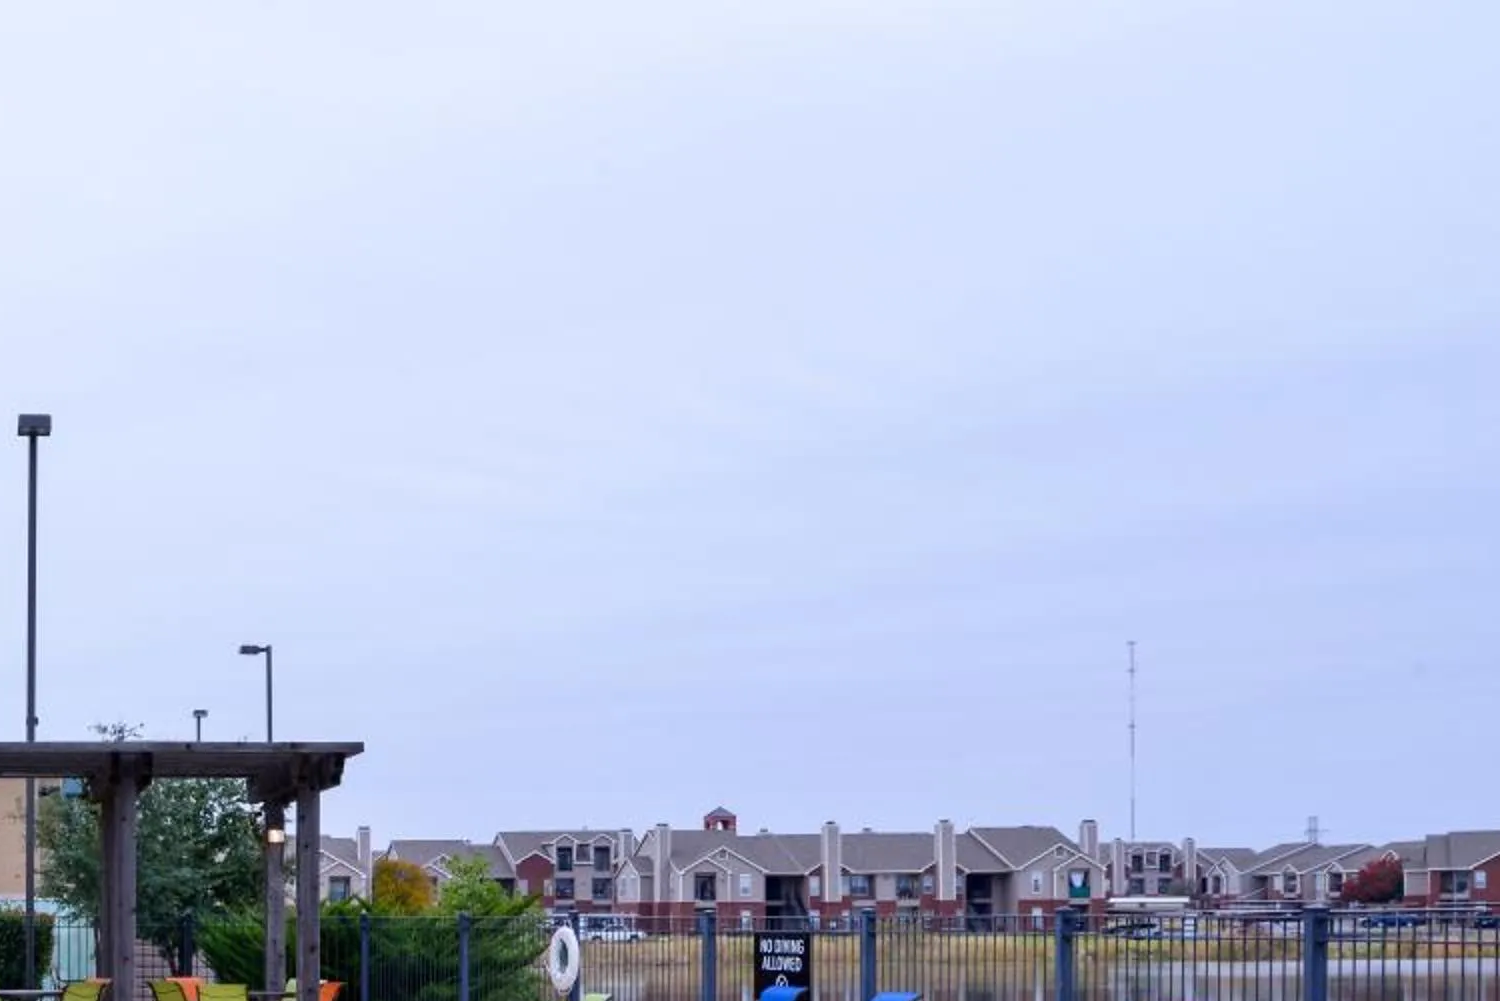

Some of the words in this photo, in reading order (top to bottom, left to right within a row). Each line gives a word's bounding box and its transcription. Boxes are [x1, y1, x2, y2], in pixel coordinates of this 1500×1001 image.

[760, 939, 773, 953] NO
[774, 939, 805, 954] DIVING
[761, 956, 803, 972] ALLOWED
